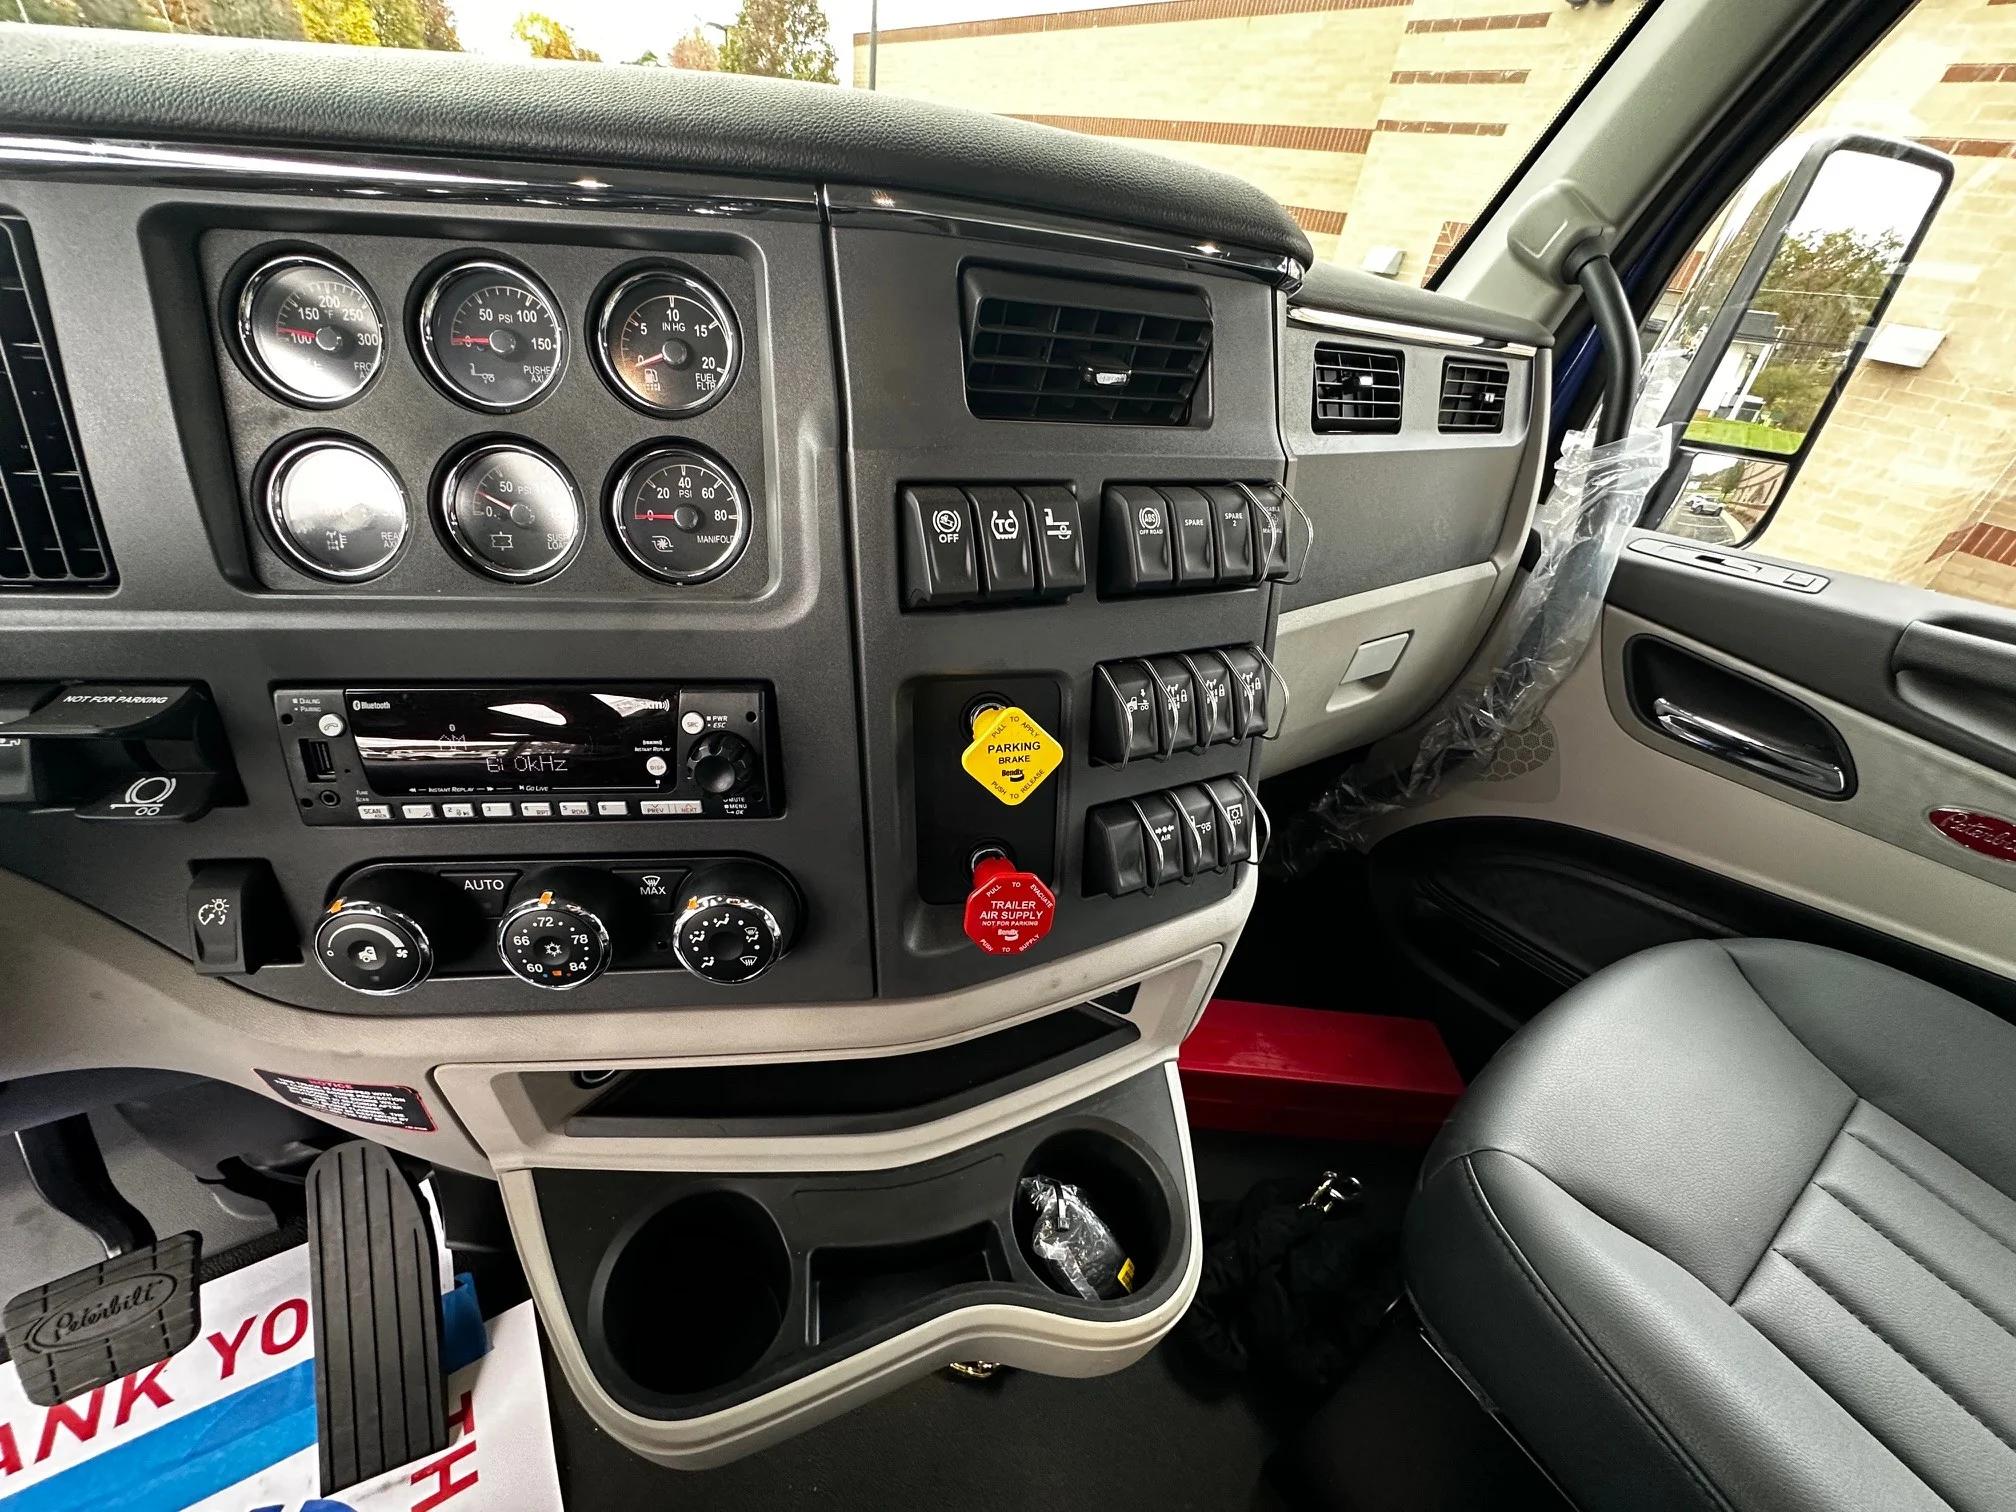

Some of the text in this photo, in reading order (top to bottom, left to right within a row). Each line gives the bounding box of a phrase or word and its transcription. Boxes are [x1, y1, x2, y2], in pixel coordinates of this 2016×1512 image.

[318, 296, 340, 308] 200
[299, 308, 320, 320] 150
[343, 309, 363, 321] 250
[479, 309, 493, 321] 50
[498, 314, 513, 323] PSI
[517, 310, 537, 322] 100
[666, 309, 680, 321] 10
[640, 323, 648, 334] 5
[662, 322, 686, 332] IN HG
[694, 325, 708, 337] 15
[291, 333, 312, 344] 100
[357, 333, 378, 346] 300
[531, 338, 552, 350] 150
[354, 362, 376, 371] FRO
[702, 357, 716, 370] 20
[695, 373, 716, 382] FUEL
[696, 382, 716, 390] FLTR
[500, 482, 513, 493] 50
[678, 477, 691, 488] 40
[657, 488, 670, 498] 20
[679, 490, 692, 498] PSI
[702, 488, 714, 498] 60
[486, 506, 492, 516] 0
[714, 510, 727, 521] 80
[1224, 512, 1243, 520] SPARE
[1144, 513, 1156, 522] ABS
[995, 518, 1015, 532] TC
[938, 534, 959, 544] OFF
[115, 696, 168, 704] PARKING
[361, 702, 390, 710] Bluetooth
[992, 723, 1006, 738] PULL
[1021, 722, 1039, 738] APPLY
[988, 741, 1040, 754] PARKING
[998, 754, 1030, 764] BRAKE
[1002, 768, 1024, 776] Bendix
[991, 780, 1007, 796] PUSH
[1020, 768, 1045, 793] RELEASE
[1160, 834, 1172, 842] AIR
[464, 879, 504, 892] AUTO
[640, 886, 666, 896] MAX
[986, 884, 1002, 898] PULL
[1030, 884, 1054, 908] EVACUATE
[990, 900, 1036, 910] TRAILER
[980, 911, 1043, 920] AIR SUPPLY
[538, 916, 554, 928] 72
[513, 936, 530, 946] 66
[570, 934, 588, 945] 78
[980, 938, 994, 952] PUSH
[1018, 934, 1040, 952] SUPPLY
[526, 962, 544, 974] 60
[569, 962, 588, 972] 84
[55, 1279, 164, 1342] Peterbilt
